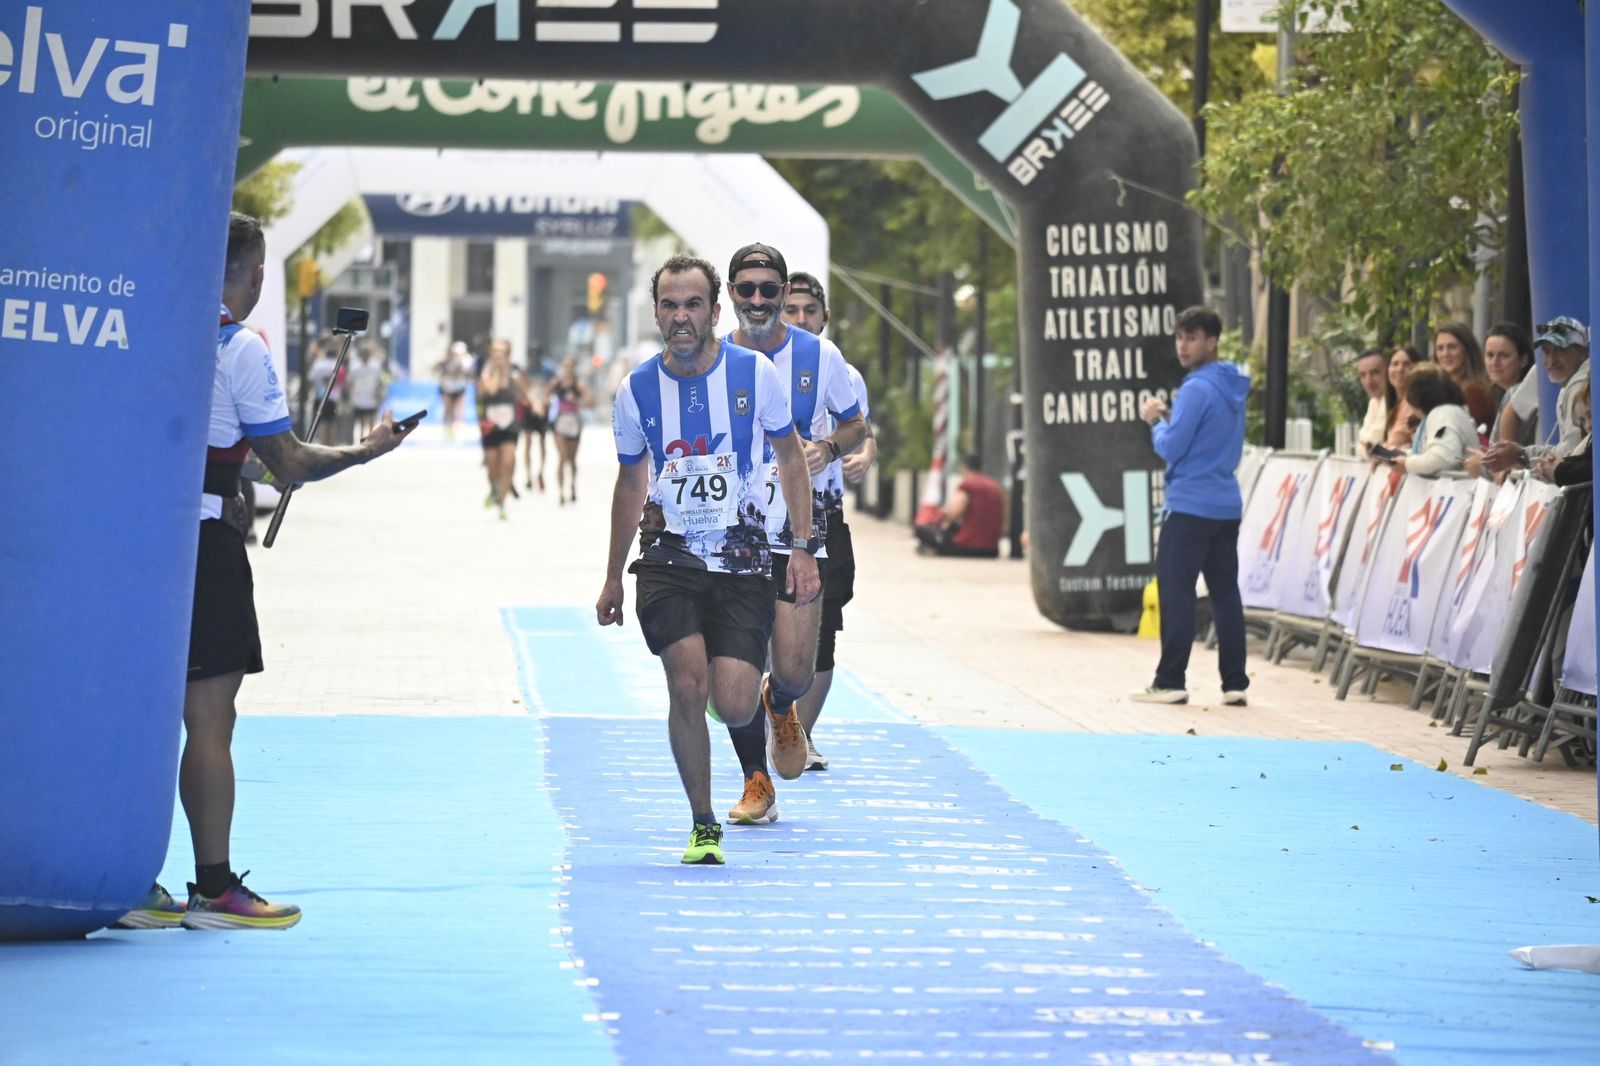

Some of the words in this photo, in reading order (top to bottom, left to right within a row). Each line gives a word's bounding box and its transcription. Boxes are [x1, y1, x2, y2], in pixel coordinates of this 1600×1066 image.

[34, 110, 153, 151] original
[1046, 220, 1169, 257] CICLISMO
[0, 267, 102, 294] amiento
[108, 273, 136, 297] de
[1048, 258, 1168, 298] TRIATLÓN
[1, 298, 130, 350] ELVA
[1043, 304, 1176, 341] ATLETISMO
[1072, 346, 1149, 382] TRAIL
[671, 474, 728, 505] 749
[682, 514, 720, 526] Huelva
